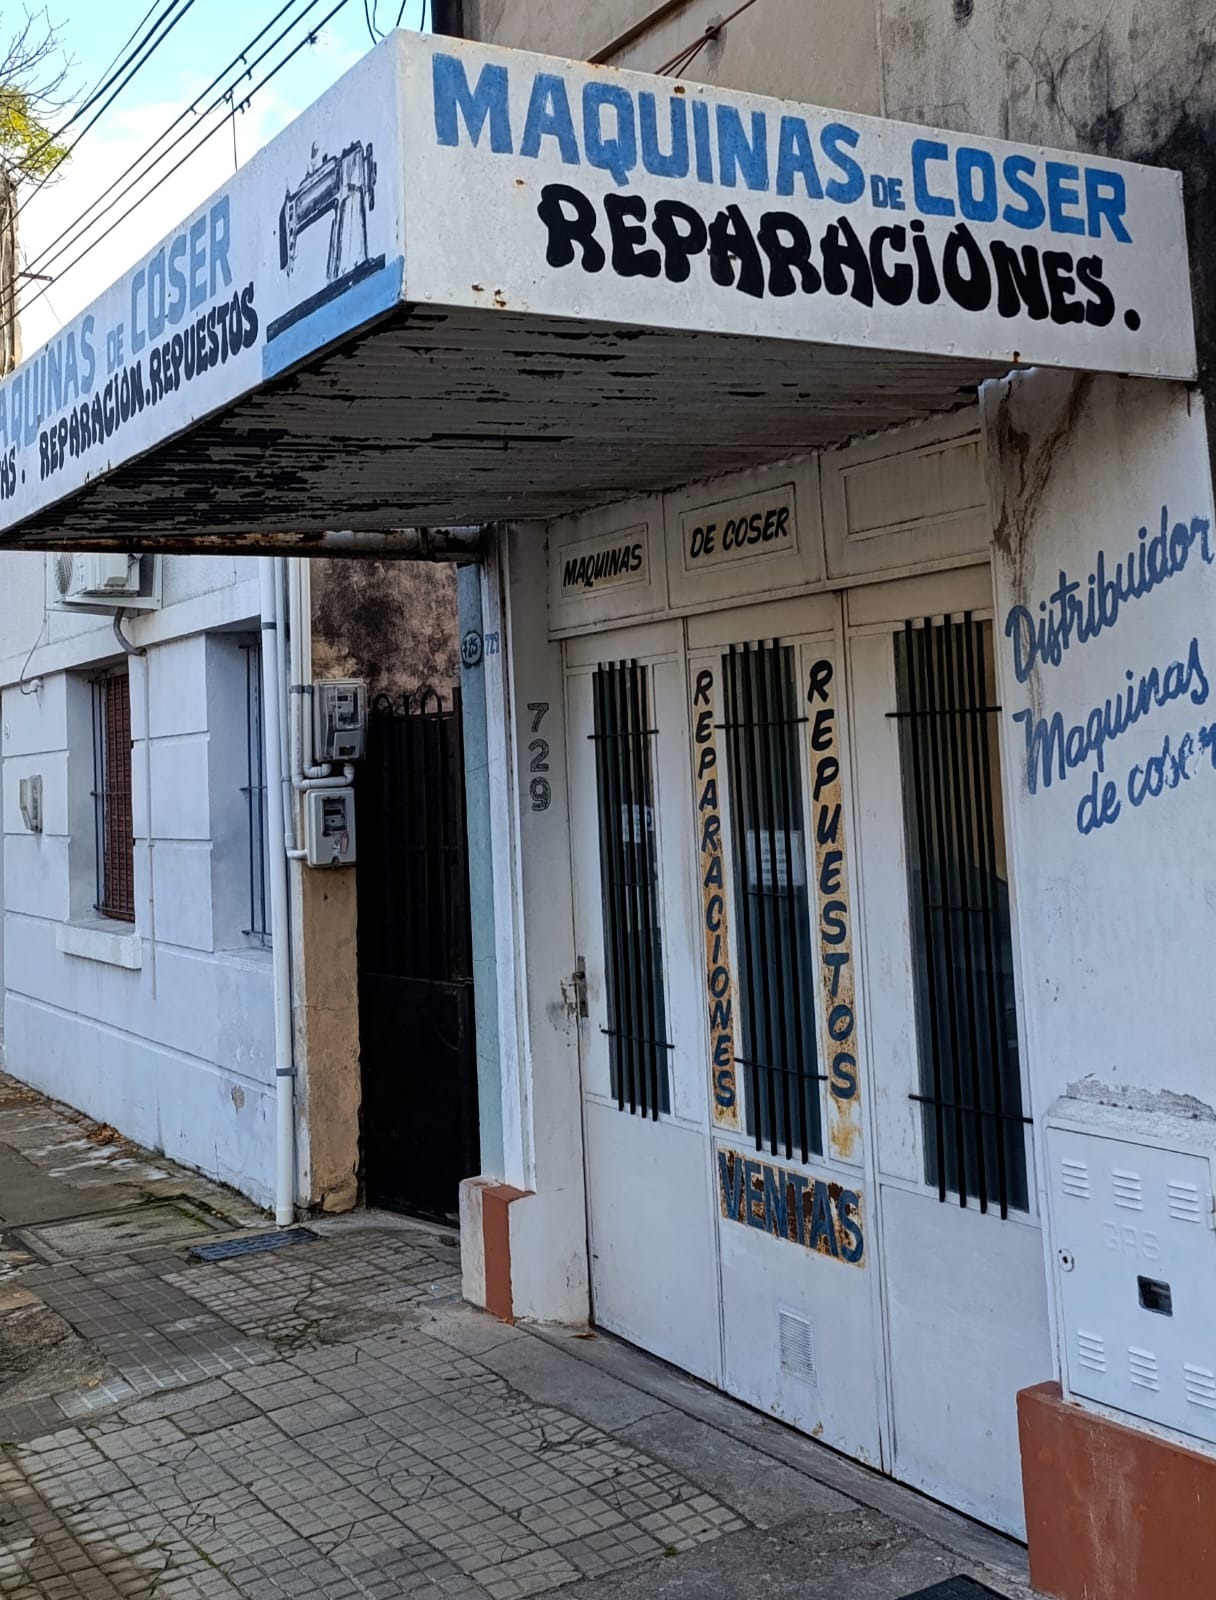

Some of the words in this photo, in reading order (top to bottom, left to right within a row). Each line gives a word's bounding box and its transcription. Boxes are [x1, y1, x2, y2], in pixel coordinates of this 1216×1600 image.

[432, 53, 866, 204] MAQUINAS
[871, 175, 905, 210] DE
[911, 139, 1133, 243] COSER
[106, 322, 124, 375] DE
[131, 194, 233, 355] COSER
[562, 544, 643, 587] MAQUINAS
[690, 524, 717, 558] DE
[722, 507, 790, 550] COSER
[1006, 505, 1215, 684] Distribuidor
[527, 702, 552, 812] 729
[1013, 637, 1209, 795] Maquinas
[807, 660, 857, 1100] REPUESTOS
[1077, 771, 1121, 835] de
[694, 669, 736, 1108] REPARACIONES
[718, 1150, 865, 1263] VENTAS
